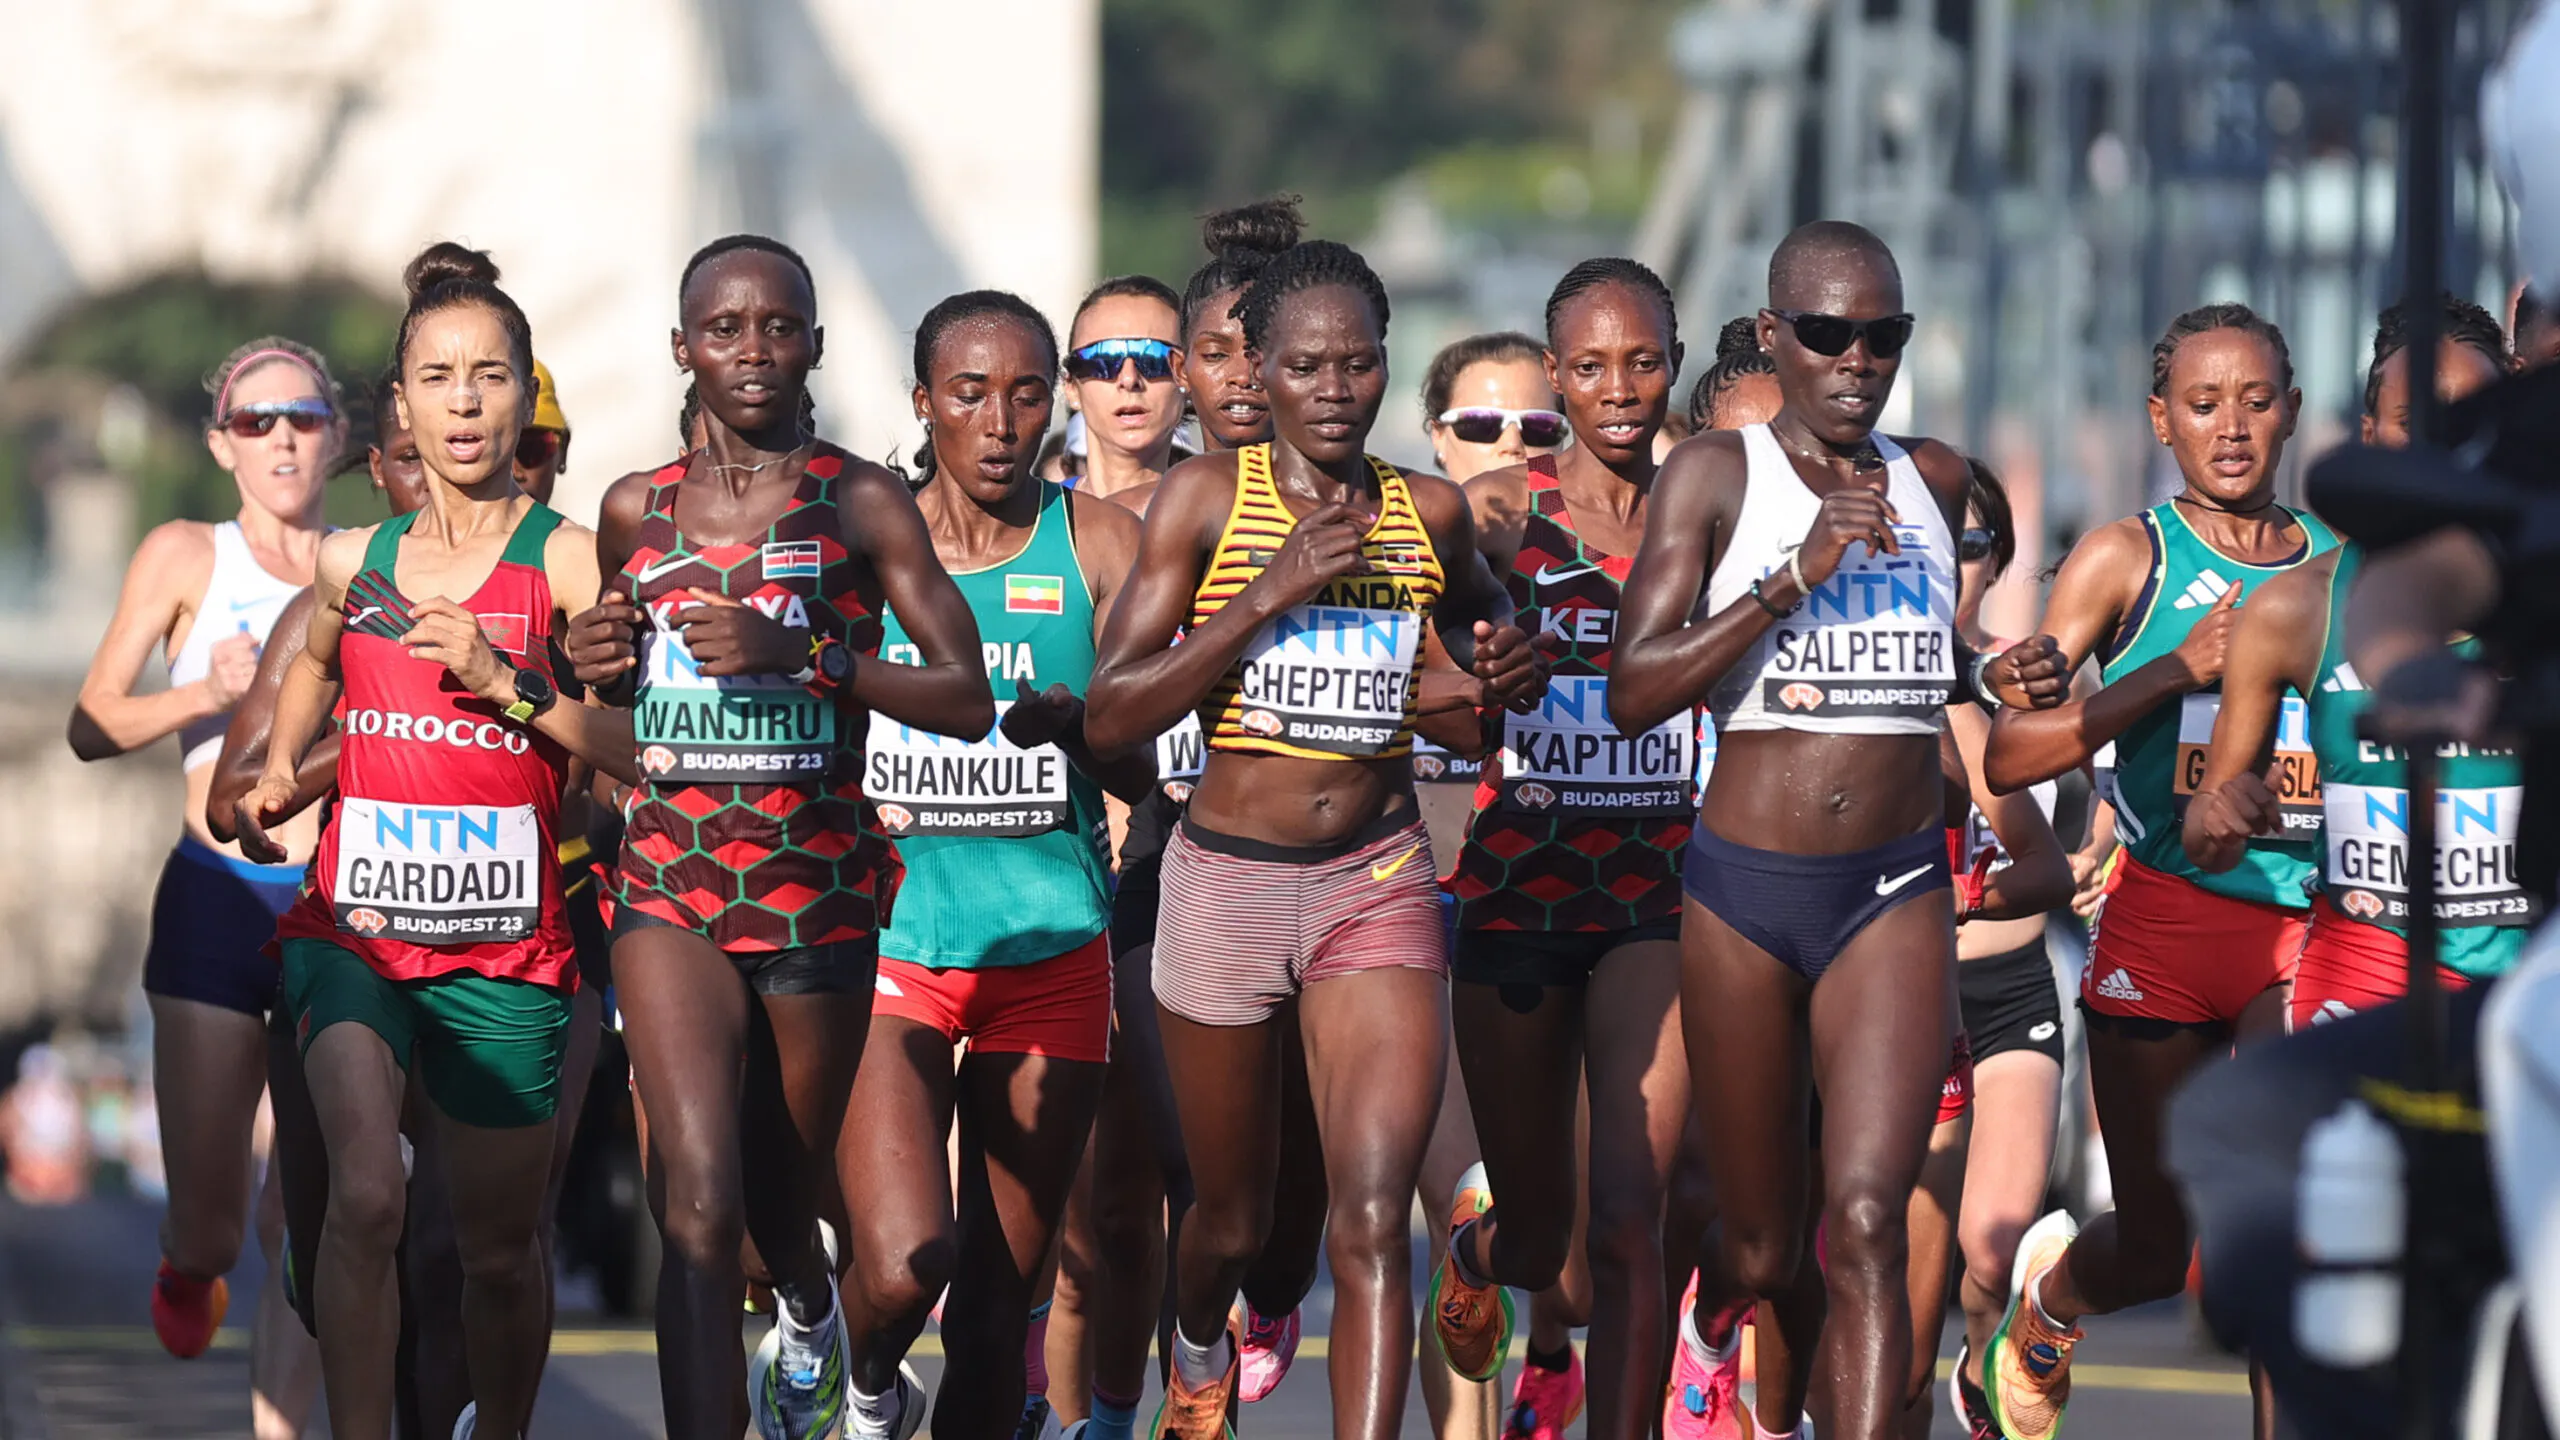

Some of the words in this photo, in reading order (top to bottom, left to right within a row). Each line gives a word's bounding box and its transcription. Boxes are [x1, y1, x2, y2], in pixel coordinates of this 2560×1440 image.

[1810, 573, 1928, 620] NTN
[1275, 608, 1399, 662] NTN
[1775, 629, 1944, 673] SALPETER
[1829, 689, 1927, 705] BUDAPEST
[1930, 690, 1949, 705] 23
[642, 700, 821, 742] WANJIRU
[682, 753, 795, 770] BUDAPEST
[798, 754, 823, 769] 23
[871, 751, 1056, 797] SHANKULE
[1516, 730, 1682, 776] KAPTICH
[919, 811, 1028, 827] BUDAPEST
[1030, 810, 1054, 825] 23
[1562, 791, 1661, 807] BUDAPEST
[1663, 790, 1681, 805] 23
[2364, 792, 2499, 838] NN
[376, 806, 498, 855] NTN
[348, 857, 525, 904] GARDADI
[393, 916, 498, 934] BUDAPEST
[499, 916, 523, 932] 23
[2388, 900, 2501, 919] BUAPEST
[2502, 897, 2529, 914] 23
[2096, 985, 2144, 1001] adidas
